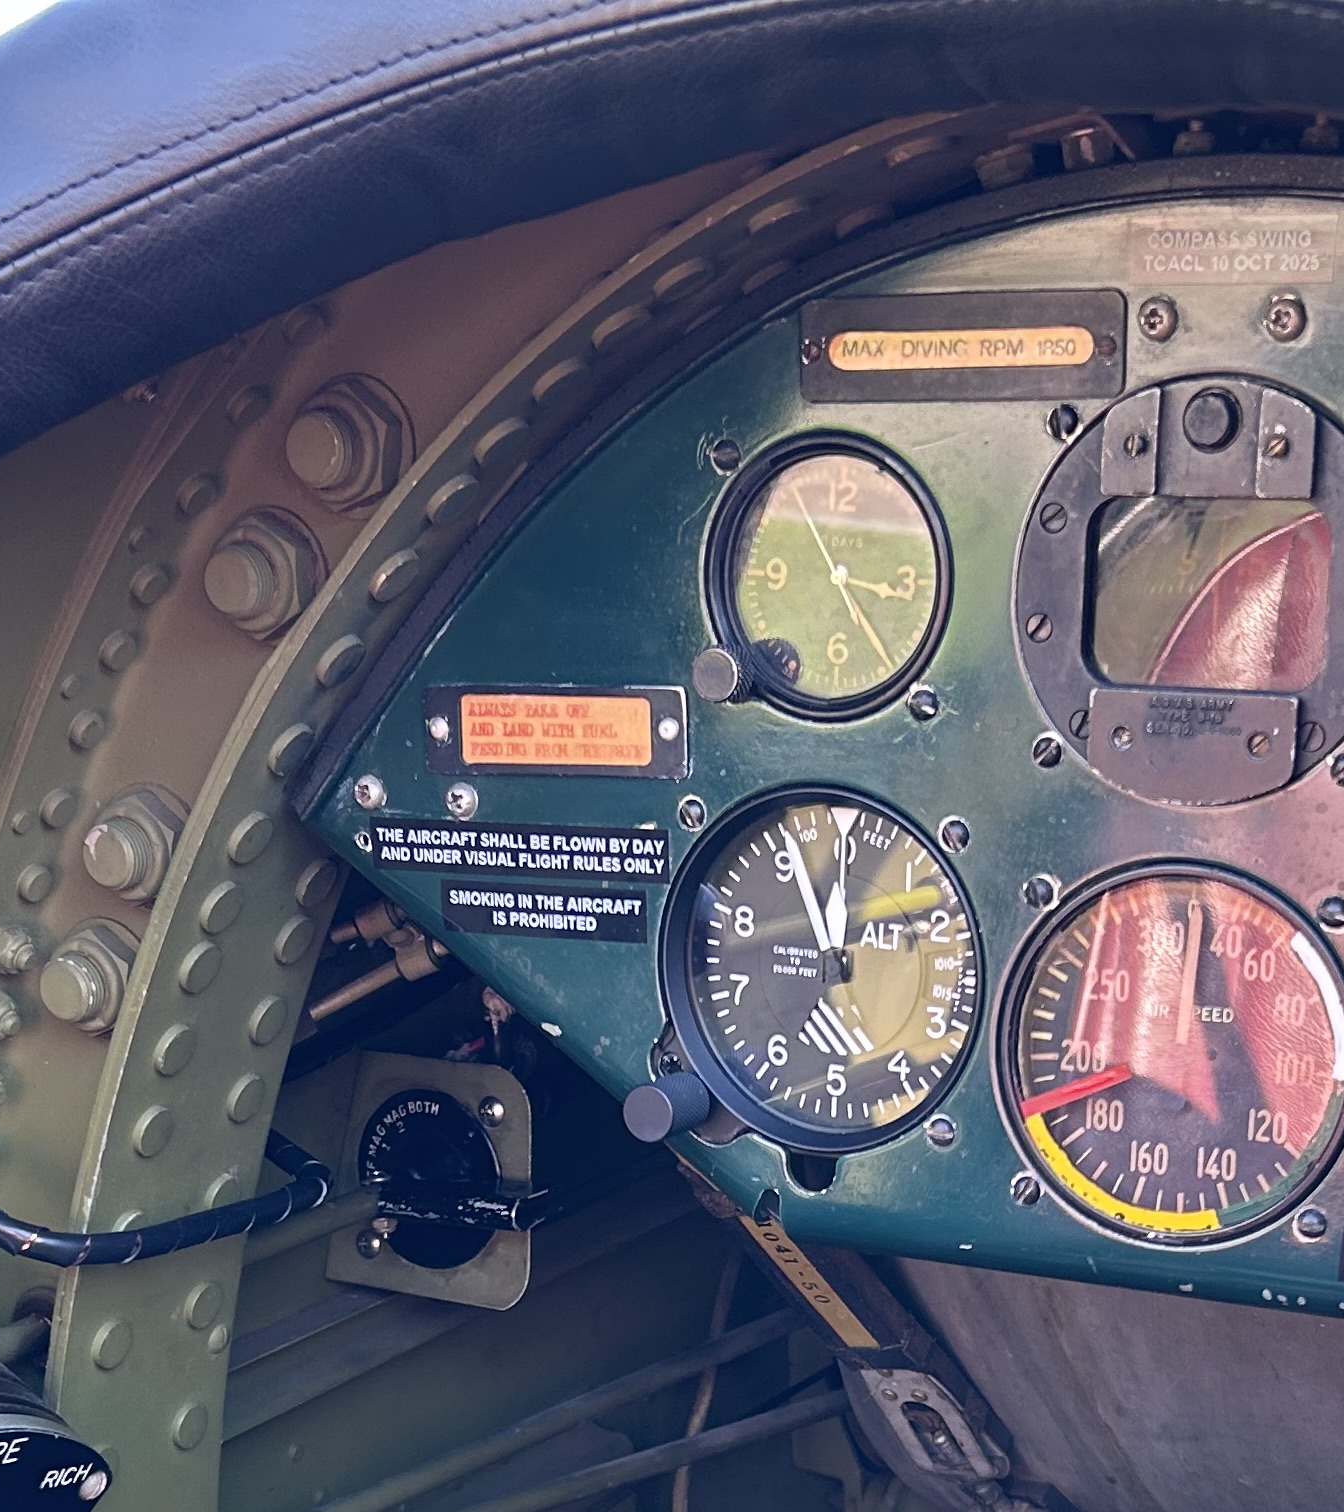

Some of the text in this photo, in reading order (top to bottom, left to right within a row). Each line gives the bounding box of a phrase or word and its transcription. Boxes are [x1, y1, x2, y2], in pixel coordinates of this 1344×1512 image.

[1147, 229, 1312, 249] COMPASS SWING
[1143, 254, 1320, 272] TCACL 10 OCT 2025
[842, 339, 884, 358] MAX
[901, 339, 967, 358] DIVING
[979, 338, 1024, 357] RPM
[829, 480, 858, 513] 12
[765, 556, 788, 592] 9
[896, 564, 917, 599] 3
[826, 631, 850, 666] 6
[469, 721, 494, 737] AND
[502, 722, 535, 738] LAND
[541, 723, 575, 739] WITH
[376, 827, 665, 856] THE AIRCRAFT SHALL BE FLOWN BY DAY
[800, 829, 818, 843] 100
[863, 829, 892, 852] FEET
[381, 846, 665, 875] AND UNDER VISUAL FLIGHT RULES ONLY
[774, 850, 796, 883] 9
[449, 888, 642, 917] SMOKING IN THE AIRCRAFT
[492, 909, 598, 932] IS PROHIBITED
[734, 905, 755, 938] 8
[860, 921, 905, 951] ALT
[930, 909, 951, 943] 2
[1209, 924, 1242, 958] 40
[1243, 947, 1276, 982] 60
[729, 973, 750, 1006] 7
[1086, 970, 1129, 1001] 250
[925, 1006, 947, 1039] 3
[767, 1033, 788, 1067] 6
[888, 1050, 911, 1082] 4
[1060, 1038, 1107, 1073] 200
[826, 1063, 848, 1097] 5
[407, 1100, 440, 1116] BOTH
[1085, 1099, 1124, 1133] 180
[1247, 1108, 1288, 1145] 120
[1129, 1140, 1169, 1176] 160
[1196, 1146, 1237, 1182] 140
[38, 1462, 93, 1491] RICH
